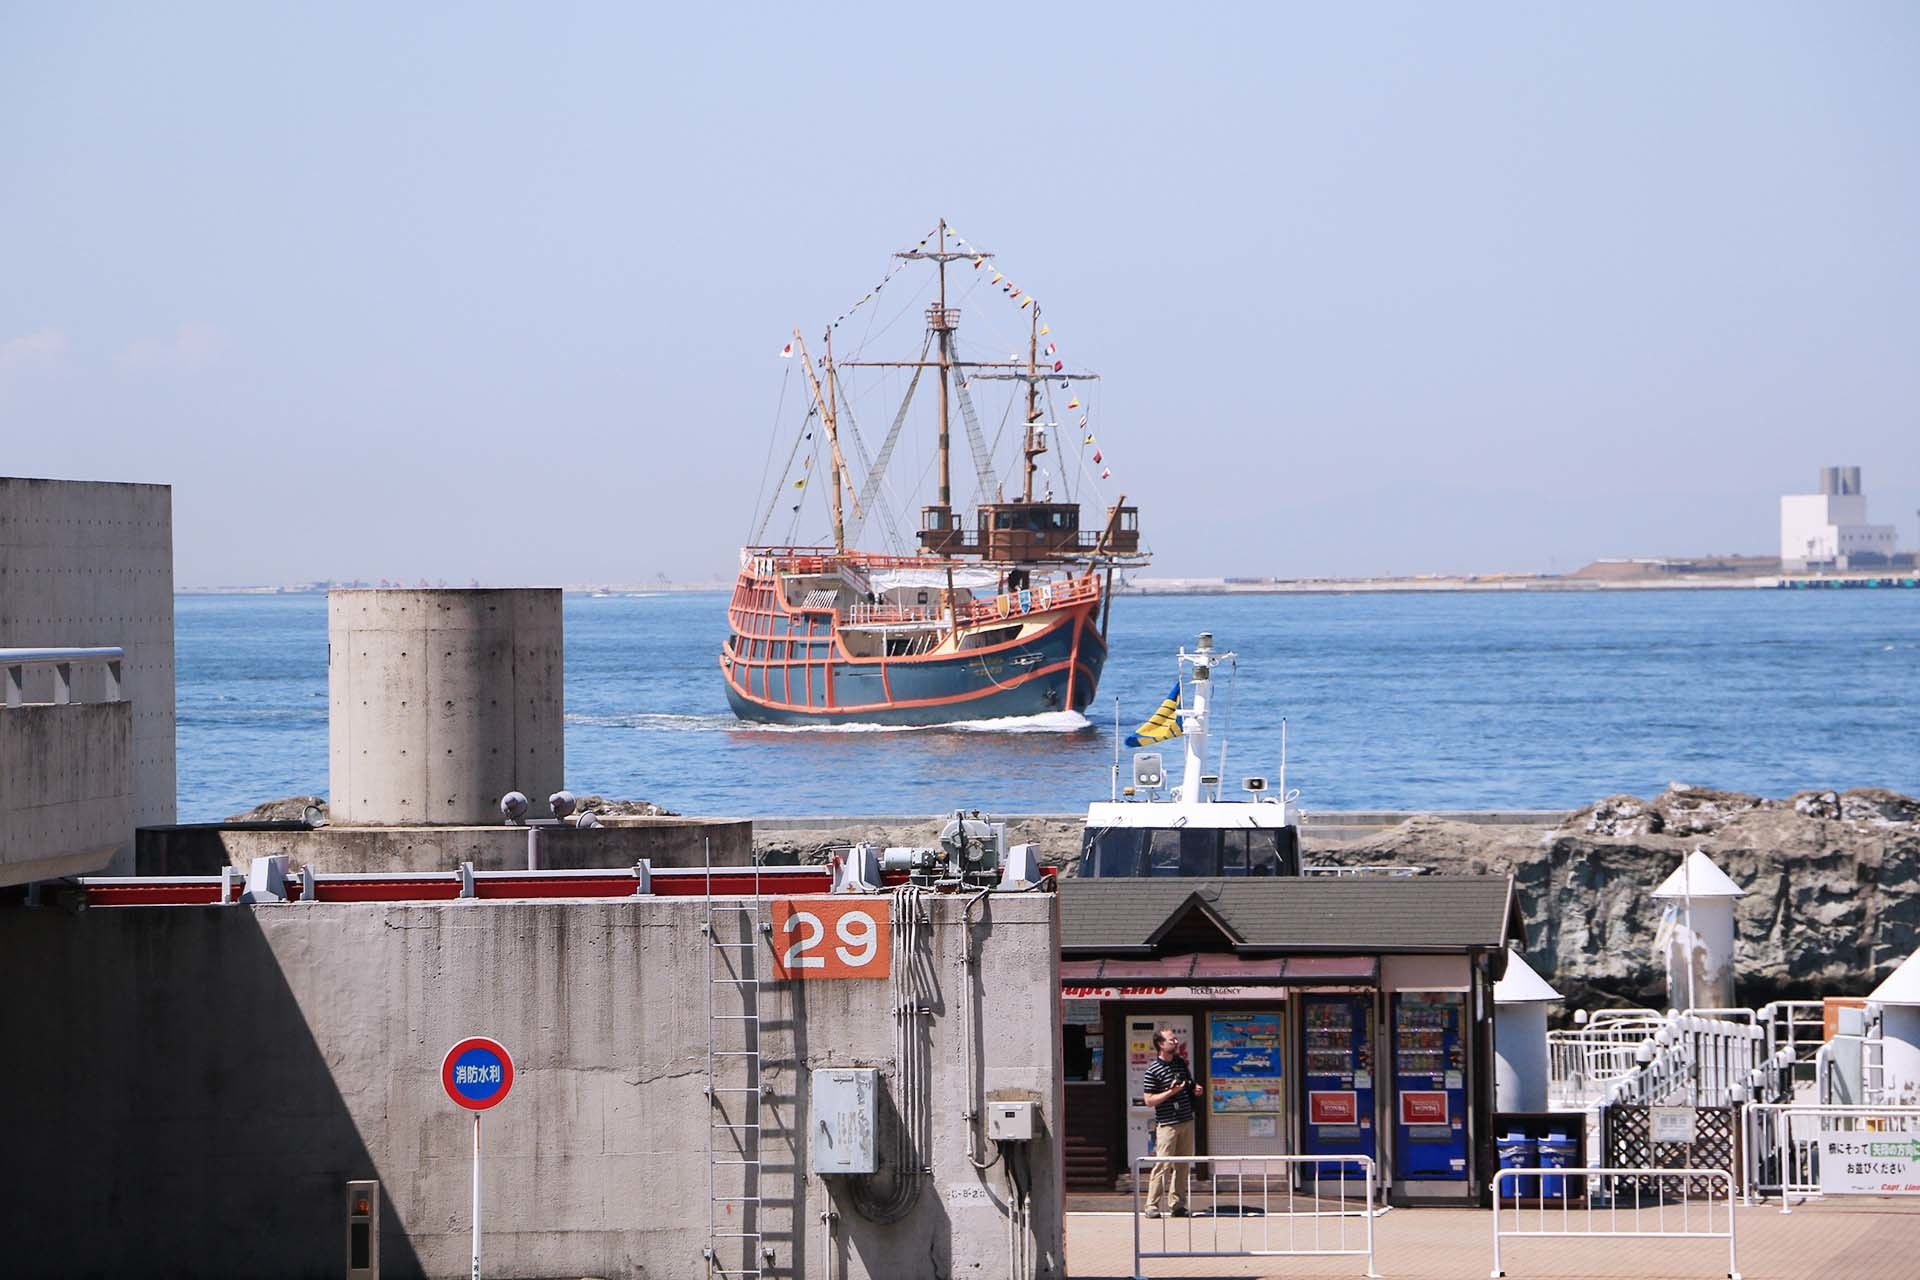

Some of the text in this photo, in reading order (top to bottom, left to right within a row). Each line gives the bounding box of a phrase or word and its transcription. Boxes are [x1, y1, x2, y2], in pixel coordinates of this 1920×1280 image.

[783, 910, 878, 968] 29
[456, 1065, 500, 1084] 消防水利
[1847, 1162, 1906, 1175] お並びください
